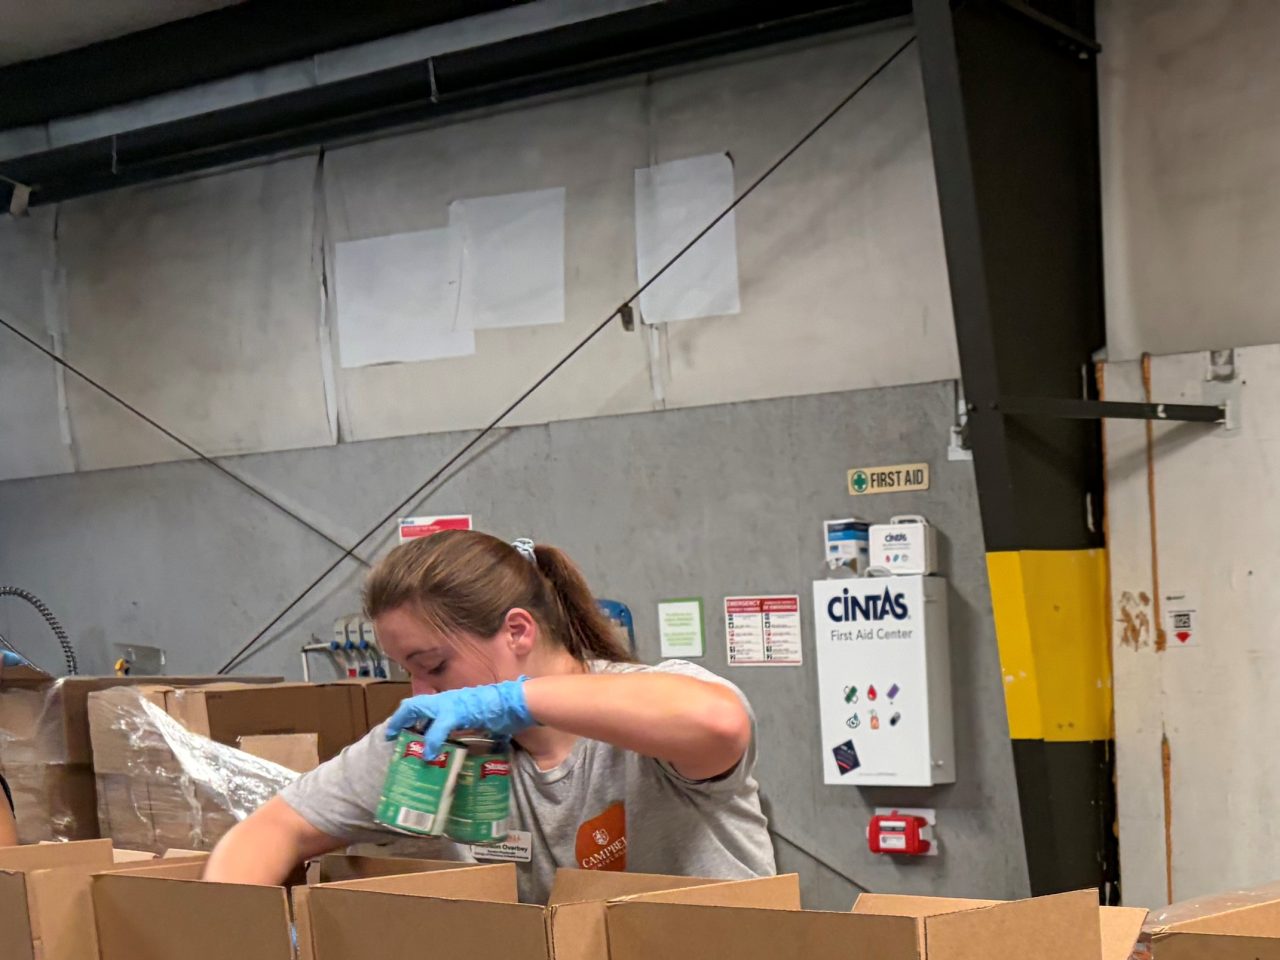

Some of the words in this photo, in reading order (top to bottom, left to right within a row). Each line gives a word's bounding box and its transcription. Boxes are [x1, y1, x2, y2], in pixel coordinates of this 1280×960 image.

[870, 471, 902, 489] FIRST
[904, 469, 924, 488] AID
[831, 629, 853, 642] First
[856, 629, 874, 641] Aid
[876, 628, 913, 640] Center
